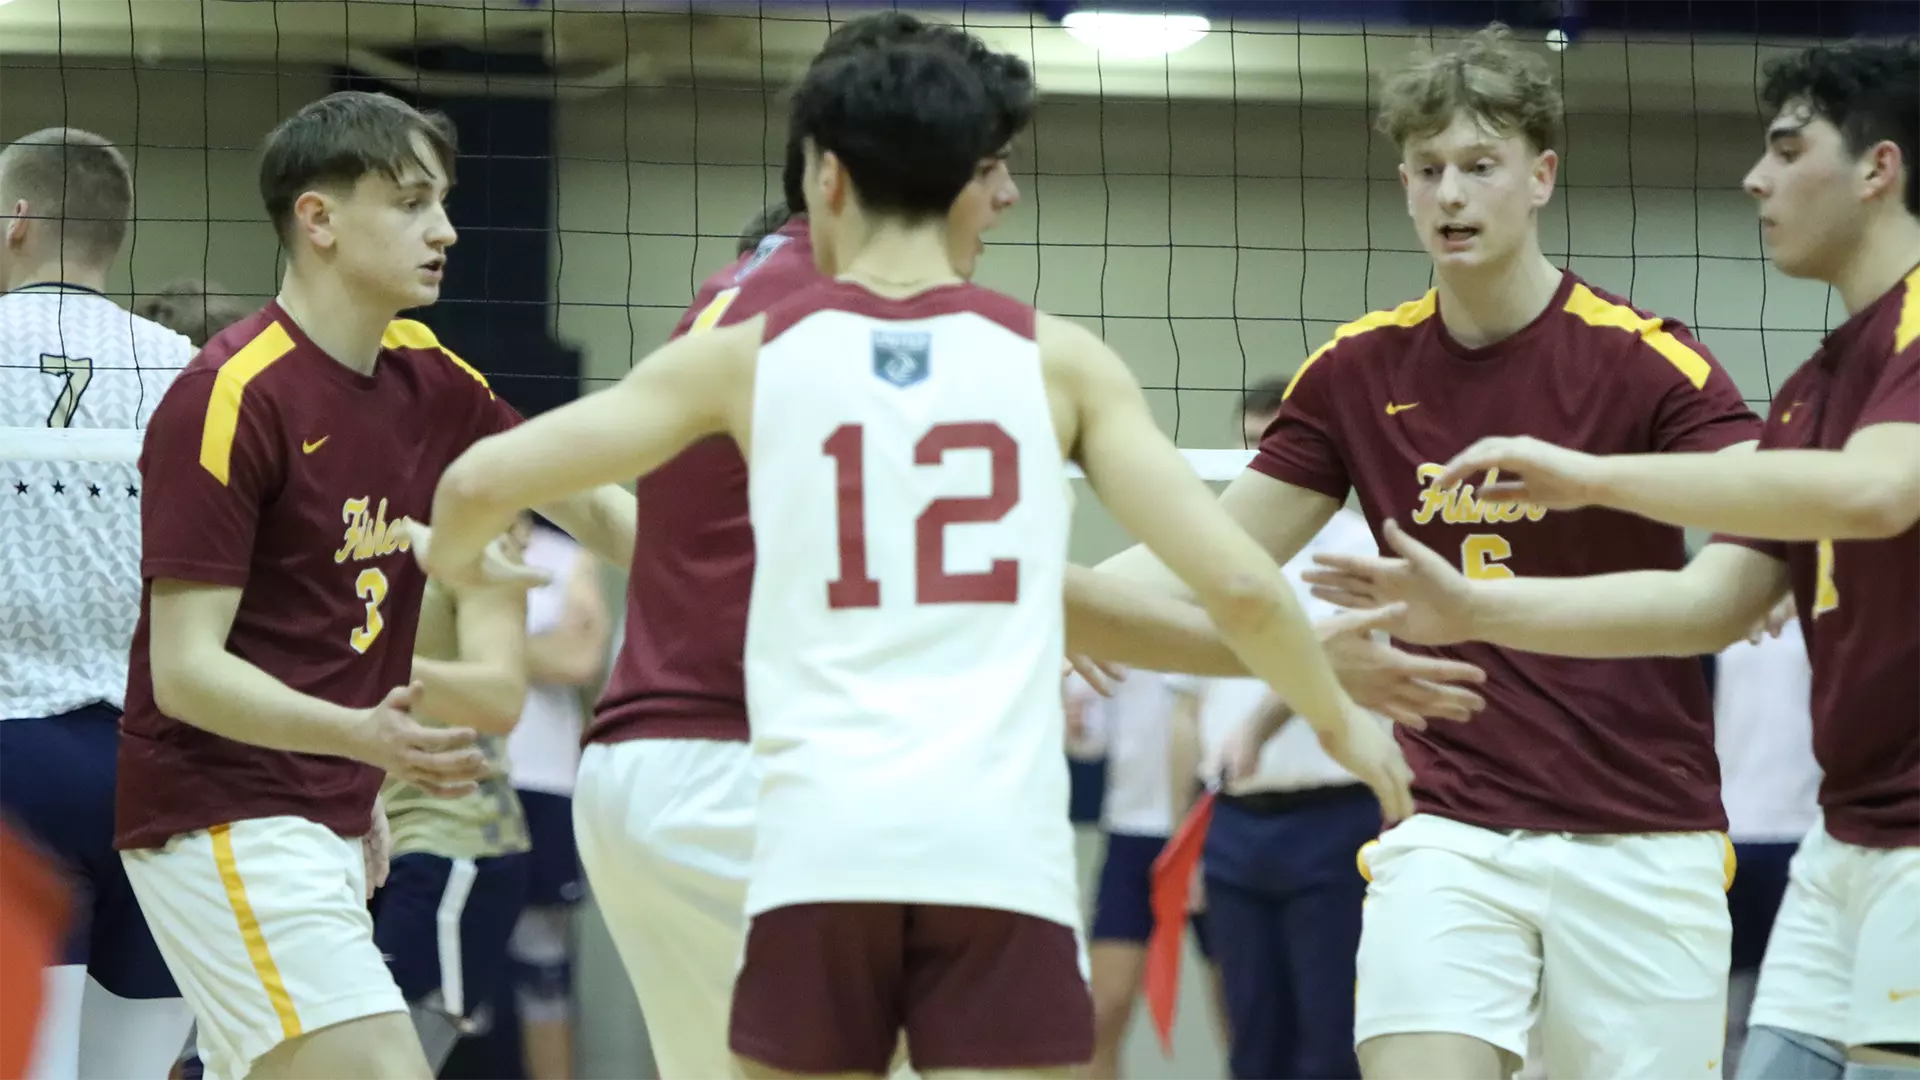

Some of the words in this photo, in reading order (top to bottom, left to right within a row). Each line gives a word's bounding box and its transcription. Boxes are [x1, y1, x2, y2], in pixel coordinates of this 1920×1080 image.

[40, 353, 93, 428] 7
[821, 420, 1021, 609] 12
[350, 567, 388, 654] 3
